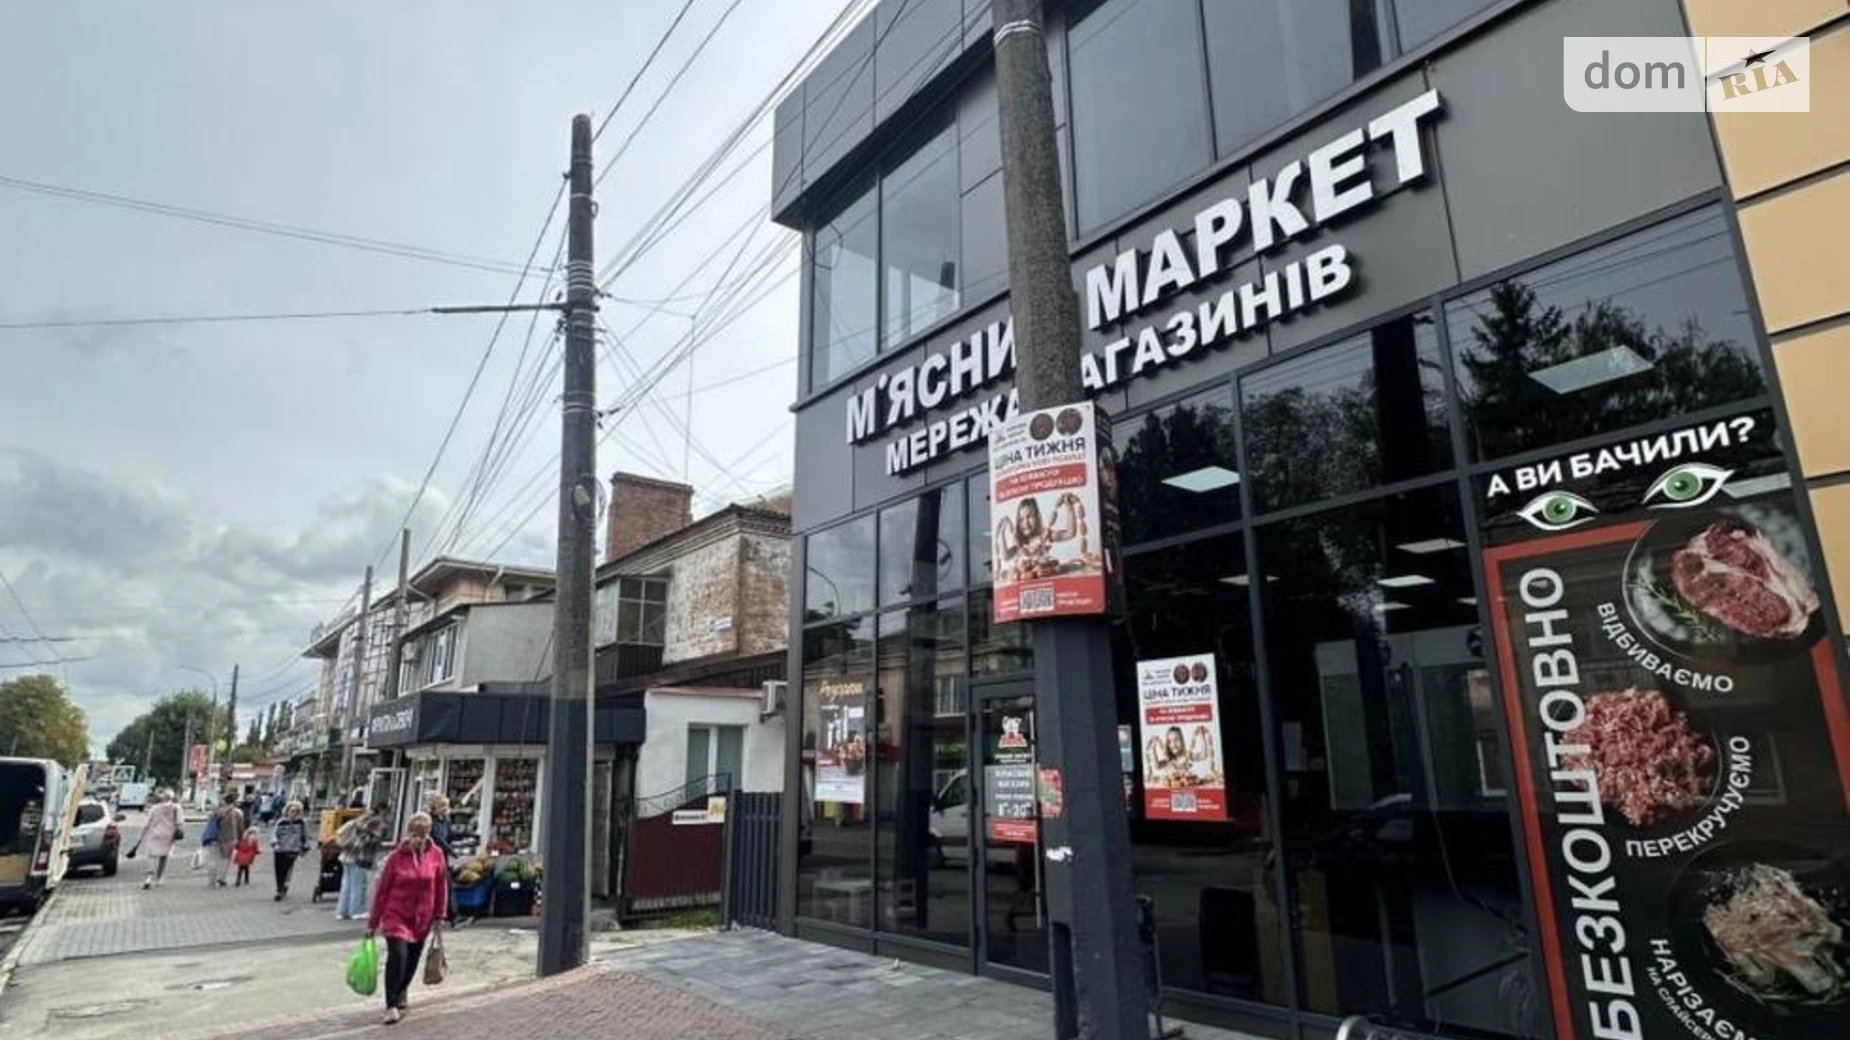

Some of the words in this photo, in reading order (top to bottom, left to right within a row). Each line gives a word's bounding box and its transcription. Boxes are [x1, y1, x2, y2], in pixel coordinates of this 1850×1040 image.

[846, 315, 1017, 445] М'ЯСНИ
[1085, 87, 1443, 330] МАРКЕТ
[1081, 243, 1353, 391] АГАЗИНІВ
[1025, 437, 1086, 459] ТИЖНЯ
[1487, 475, 1511, 498] А
[1515, 460, 1563, 491] ВИ
[1569, 416, 1756, 479] БАЧИЛИ?
[1596, 602, 1735, 694] ВІДБИВАЄМО
[1519, 567, 1643, 1040] БЕЗКОШТОВНО
[1625, 735, 1753, 859] ПЕРЕКРУЧУЄМО
[1645, 966, 1662, 987] НА
[1658, 986, 1718, 1040] СЛАЙСЕР
